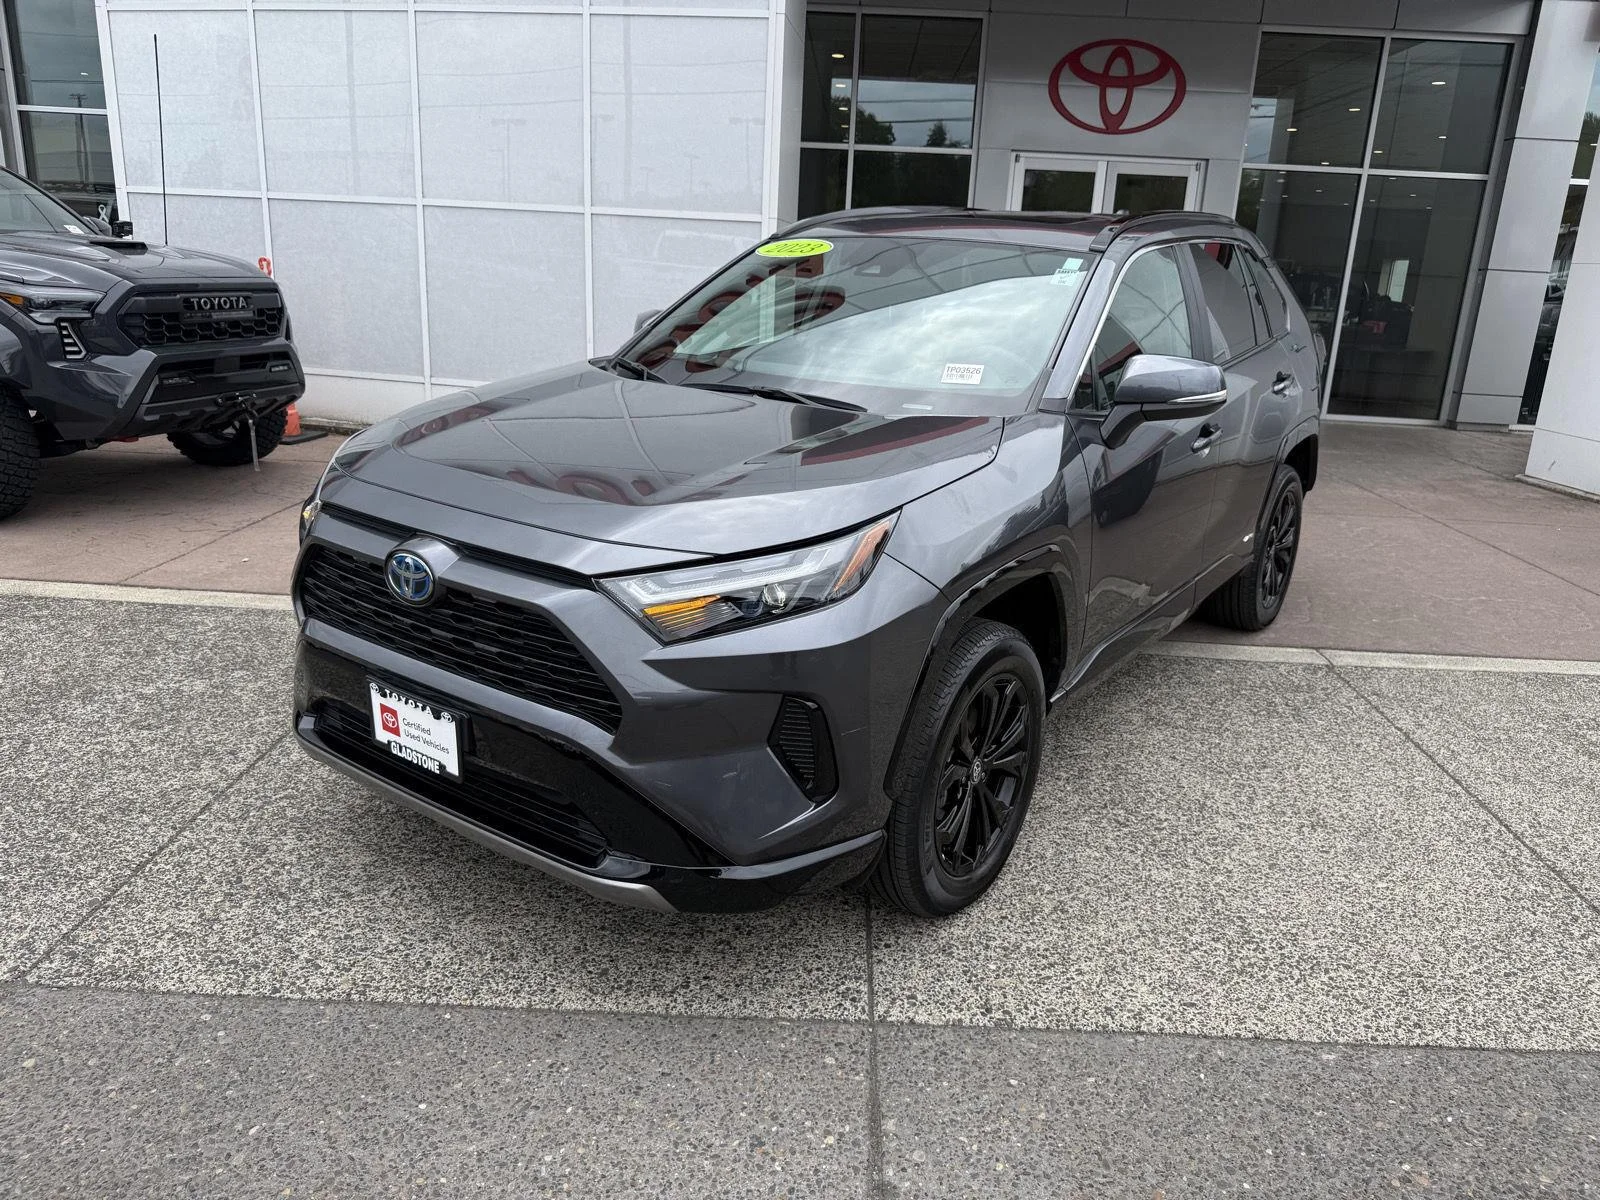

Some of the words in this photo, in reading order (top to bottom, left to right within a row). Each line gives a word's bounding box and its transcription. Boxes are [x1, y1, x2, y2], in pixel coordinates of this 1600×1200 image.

[765, 243, 823, 253] 2023
[190, 296, 248, 310] TOYOTA
[946, 366, 982, 375] TP03526
[384, 689, 434, 717] TOYOTA
[402, 717, 431, 736] Certified
[404, 728, 421, 742] Used
[421, 736, 450, 754] Vehicles
[390, 741, 441, 774] GLADSTONE
